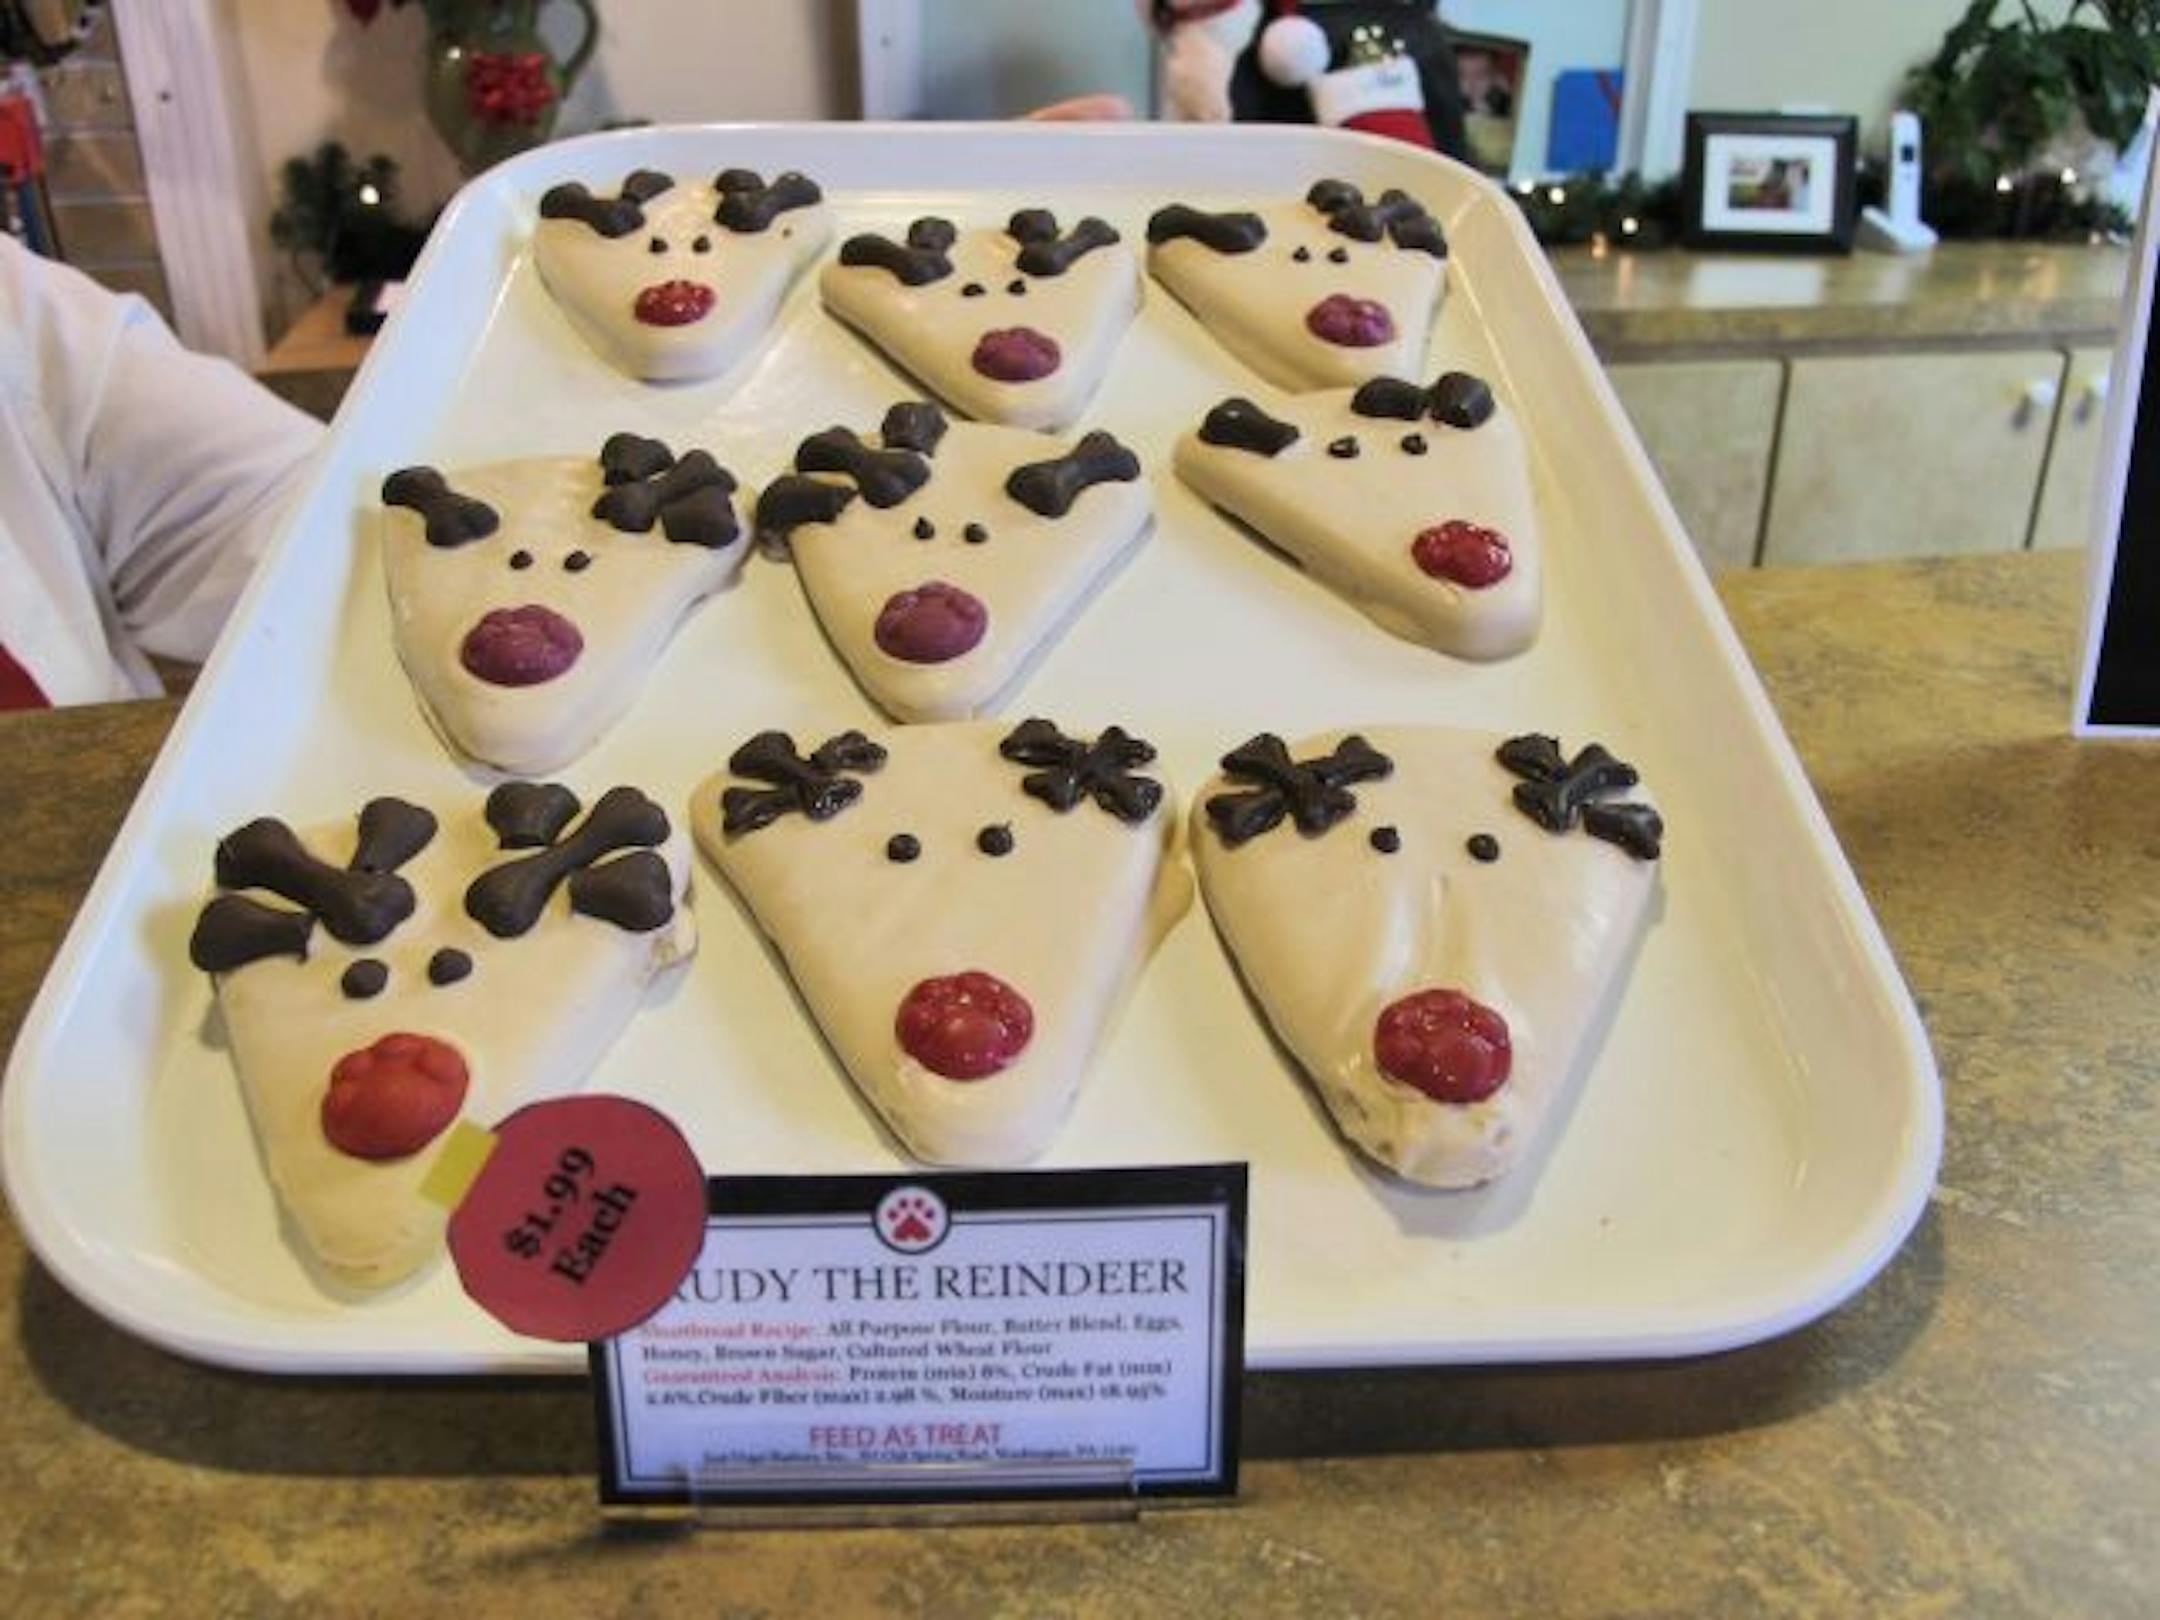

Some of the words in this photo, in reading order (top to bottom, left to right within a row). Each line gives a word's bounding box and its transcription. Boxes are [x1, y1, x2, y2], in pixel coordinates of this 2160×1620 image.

[505, 1148, 596, 1259] $1.99
[553, 1185, 636, 1286] Each
[674, 1268, 799, 1302] UDY
[814, 1264, 918, 1301] THE
[935, 1257, 1188, 1298] REINDEER
[828, 1318, 852, 1337] All
[859, 1318, 935, 1339] Purpose
[941, 1319, 998, 1336] Flour,
[1004, 1316, 1062, 1334] Butter
[1069, 1314, 1127, 1333] Blend,
[643, 1347, 710, 1363] Honey,
[715, 1346, 777, 1361] Brown
[782, 1345, 840, 1361] Sugar,
[846, 1343, 928, 1359] Cultured
[936, 1342, 994, 1357] Wheat
[1002, 1341, 1052, 1356] Flour
[849, 1367, 918, 1382] Protein
[924, 1365, 976, 1381] (min)
[1022, 1361, 1077, 1379] Crude
[1083, 1361, 1113, 1377] Fat
[759, 1388, 808, 1404] Fiber
[813, 1388, 869, 1405] (max)
[949, 1386, 1033, 1402] Moisture
[1039, 1384, 1095, 1401] (max)
[809, 1425, 875, 1449] FEED
[883, 1425, 917, 1447] AS
[926, 1423, 1002, 1445] TREAT
